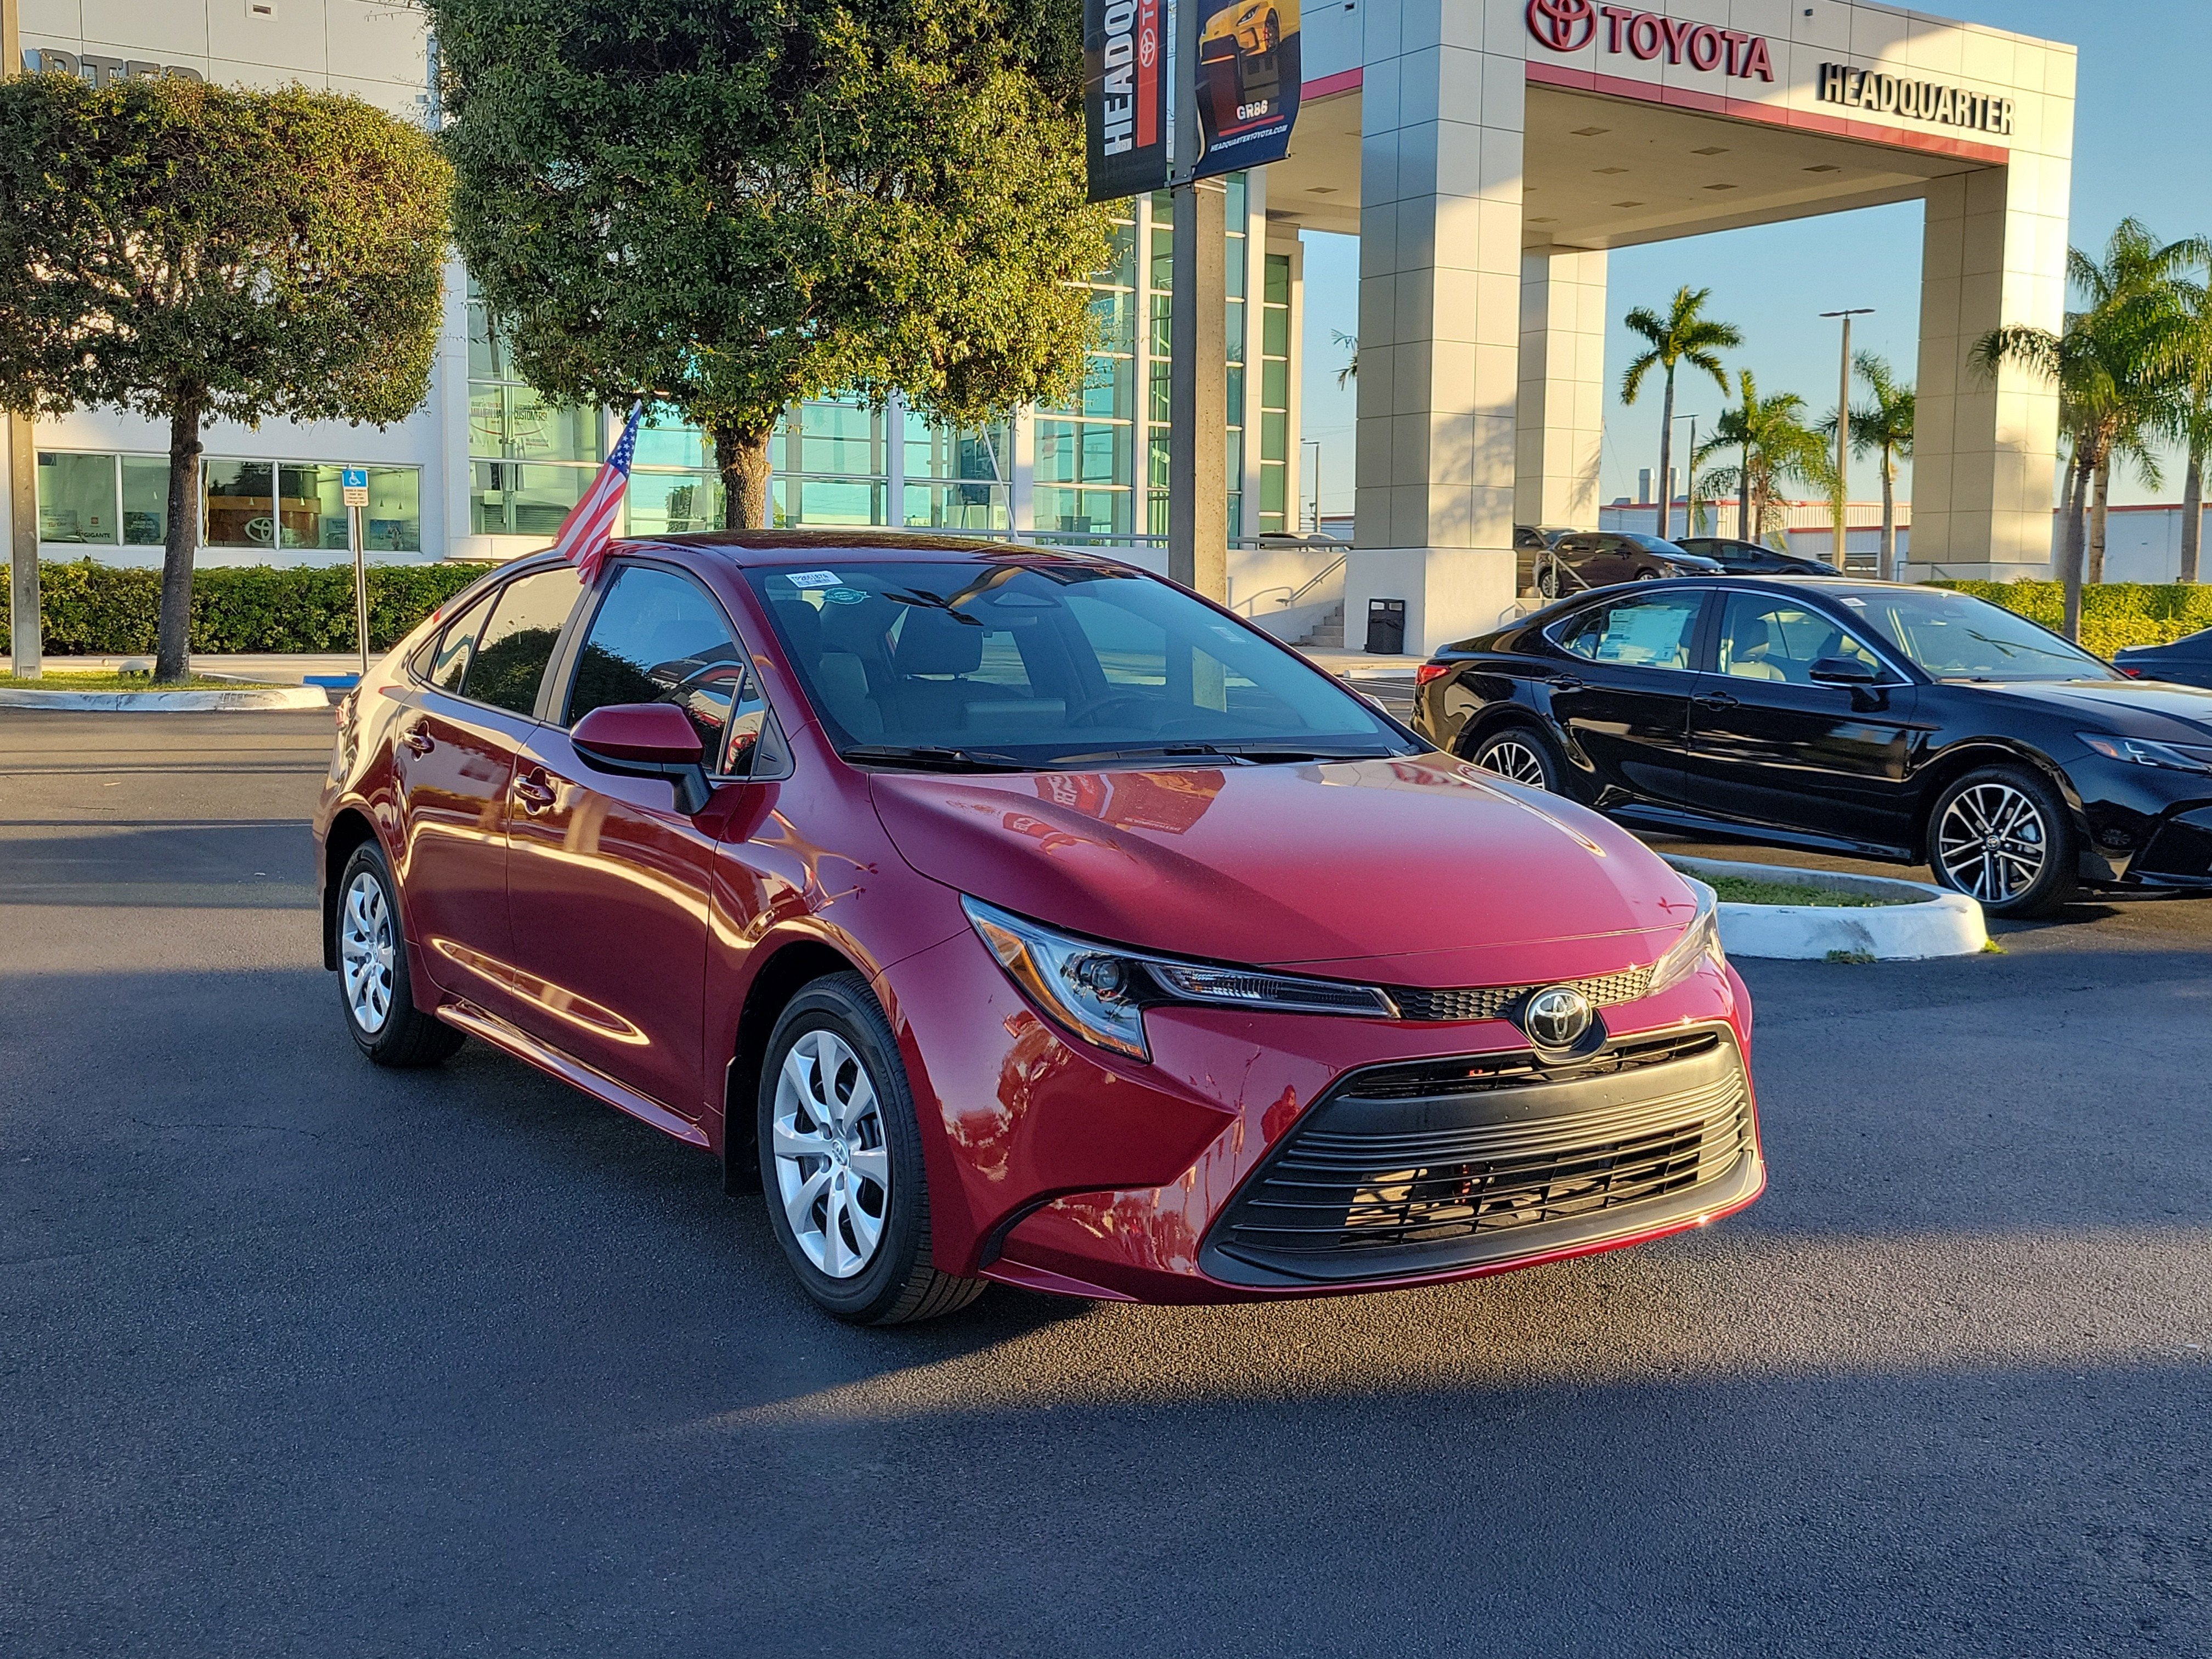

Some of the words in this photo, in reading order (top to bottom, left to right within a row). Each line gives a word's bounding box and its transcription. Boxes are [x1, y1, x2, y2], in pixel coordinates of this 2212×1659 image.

[1142, 0, 1154, 26] T
[1601, 6, 1774, 82] TOYOTA
[1104, 0, 1138, 156] HEADQ
[1818, 62, 2016, 136] HEADQUARTER
[1237, 99, 1268, 120] GR86
[1210, 124, 1288, 153] HEADQUARTERTOYOTA.COM
